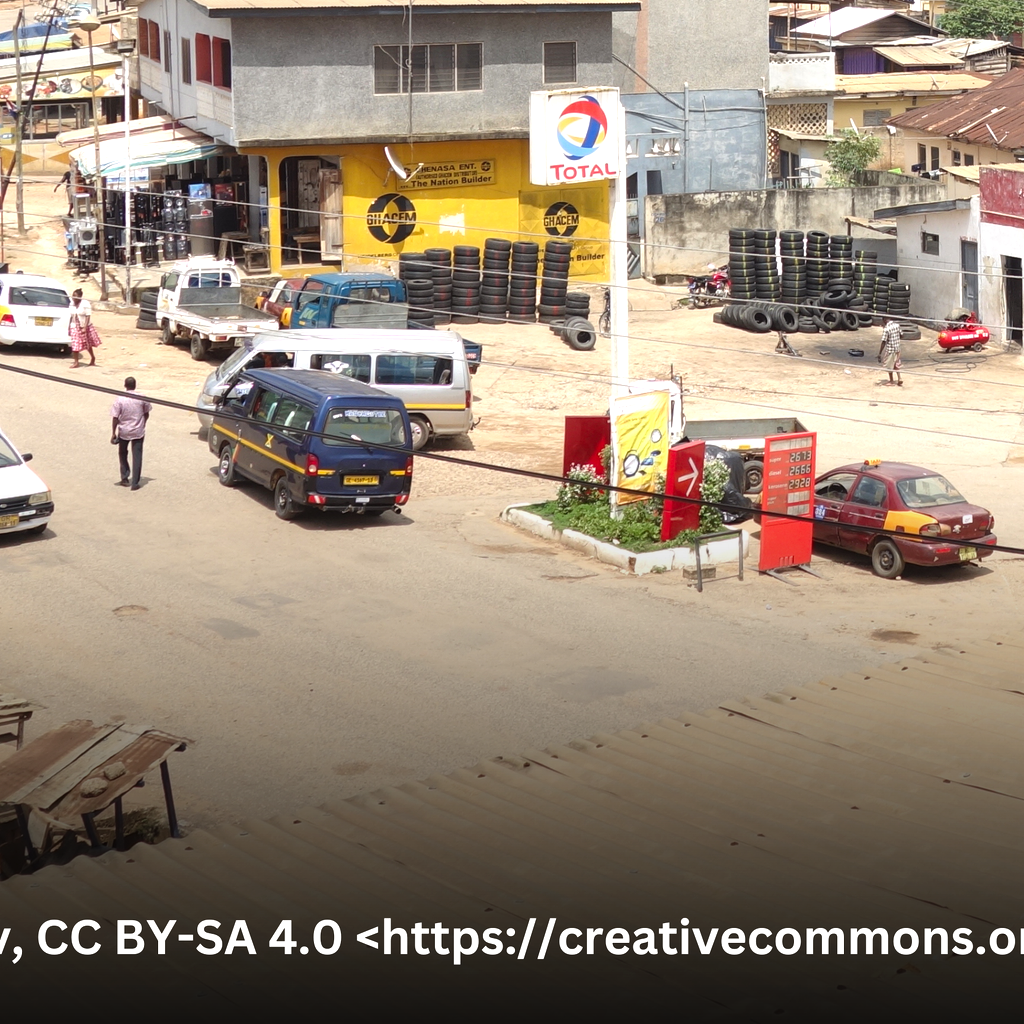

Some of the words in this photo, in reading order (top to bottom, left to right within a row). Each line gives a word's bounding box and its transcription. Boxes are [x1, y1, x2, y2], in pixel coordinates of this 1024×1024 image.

[550, 163, 617, 180] TOTAL
[411, 180, 428, 188] The
[461, 176, 492, 184] Builder
[366, 212, 417, 225] GHACEM
[543, 215, 580, 227] GHACEM
[576, 253, 605, 261] Builder
[789, 451, 812, 463] 2673
[789, 464, 811, 476] 2666
[788, 477, 811, 490] 2928
